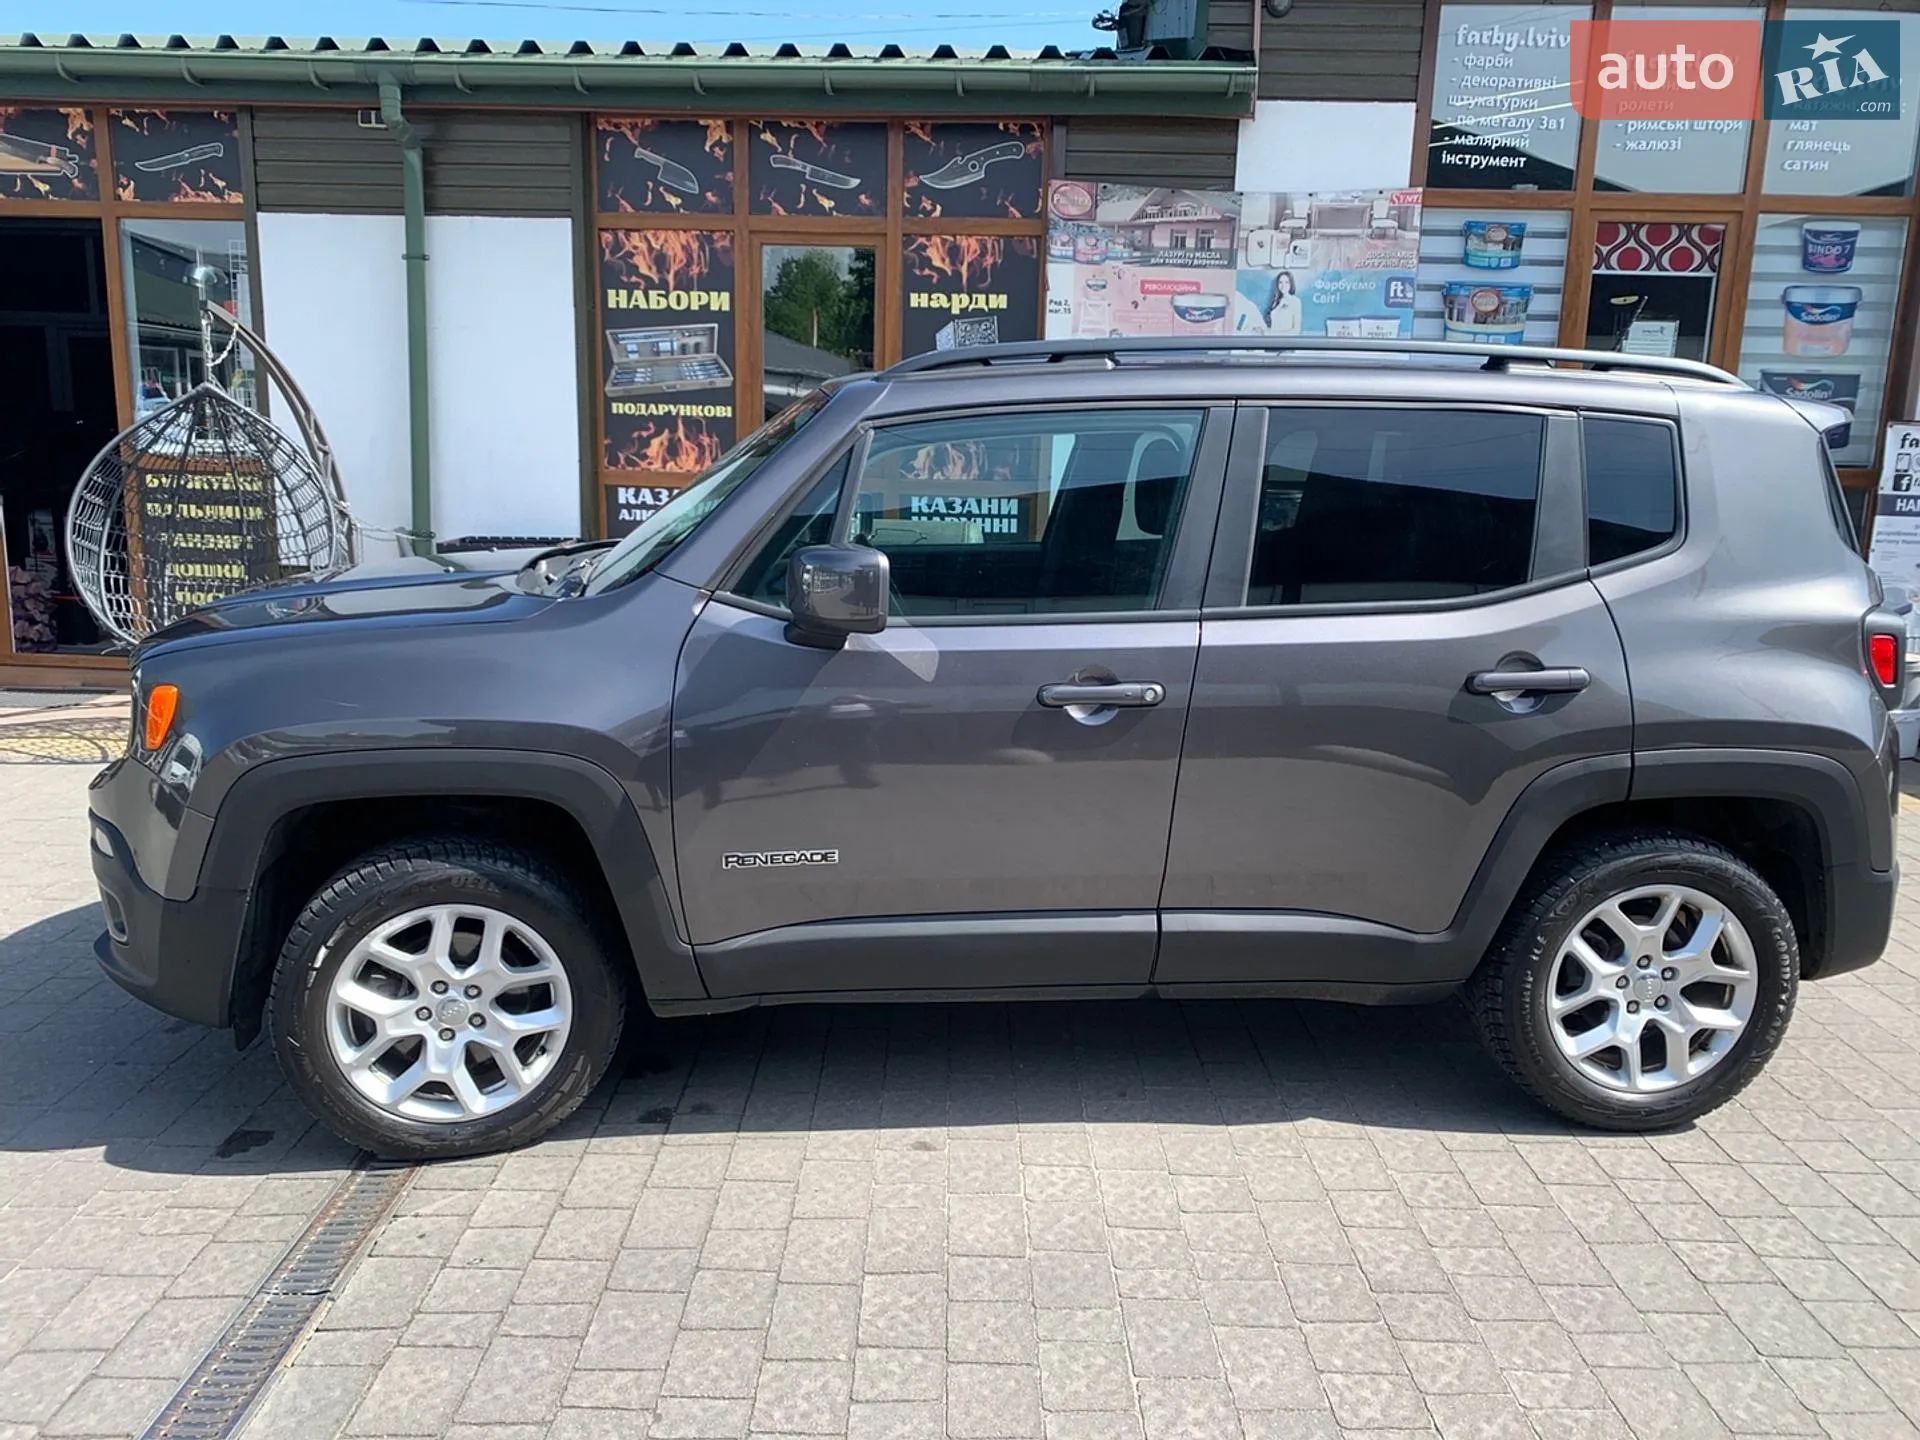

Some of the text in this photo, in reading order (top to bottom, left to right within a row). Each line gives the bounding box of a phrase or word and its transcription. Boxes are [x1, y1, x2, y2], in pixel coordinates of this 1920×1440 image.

[1456, 23, 1570, 52] farby.lviv
[1463, 53, 1514, 69] фарби
[1461, 75, 1557, 90] декоративні
[1448, 95, 1539, 110] штукатурки
[1479, 117, 1535, 129] металу
[1627, 119, 1743, 131] римські штори
[1788, 119, 1818, 131] мат
[1453, 134, 1530, 149] малярний
[1625, 137, 1681, 150] жалюзі
[1785, 140, 1851, 153] глянець
[1441, 150, 1527, 168] інструмент
[1783, 160, 1829, 171] сатин
[1808, 244, 1842, 254] BINDO
[1314, 280, 1376, 292] Фарбуємо
[607, 289, 730, 311] НАБОРИ
[910, 292, 1008, 314] нарди
[611, 402, 732, 417] ПОДАРУНКОВІ
[911, 496, 1018, 515] КАЗАНИ
[723, 849, 839, 869] RENEGADE
